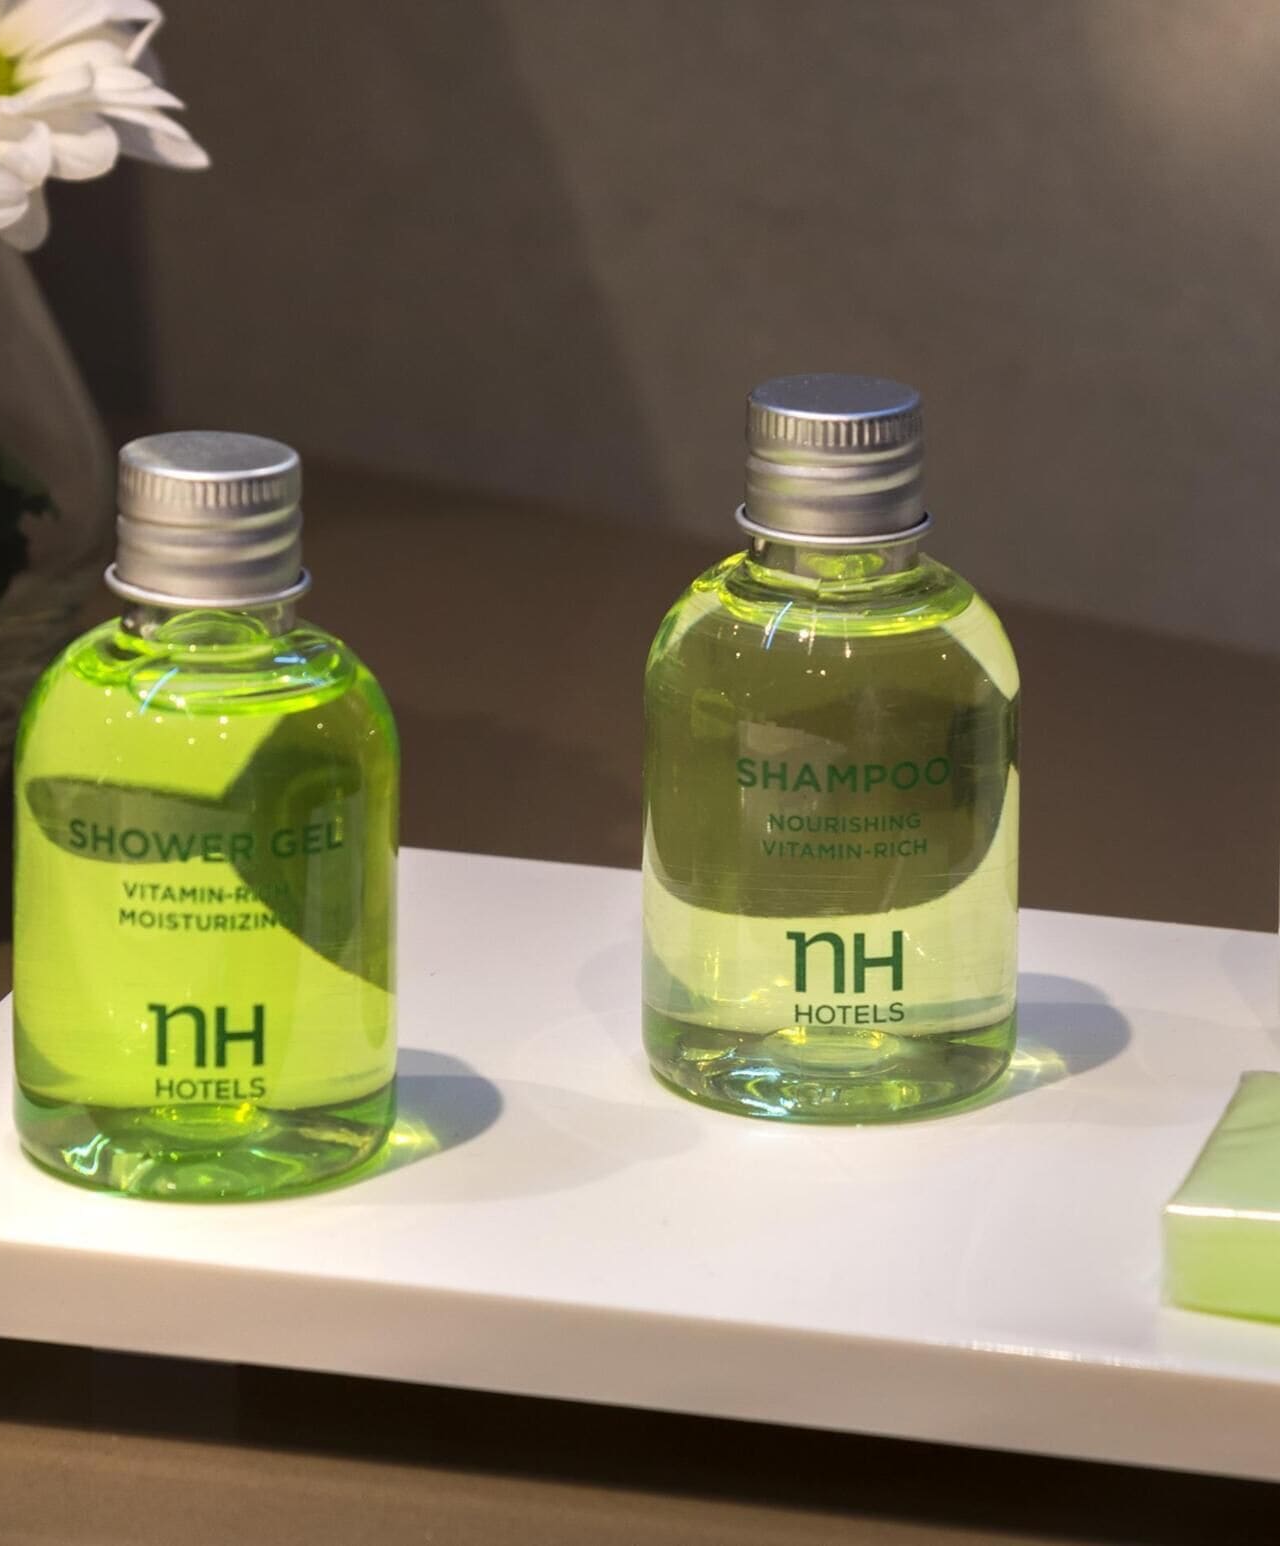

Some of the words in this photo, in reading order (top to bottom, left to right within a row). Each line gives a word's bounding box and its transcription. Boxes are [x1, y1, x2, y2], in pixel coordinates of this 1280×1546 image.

[736, 757, 951, 793] SHAMPOO
[769, 812, 921, 834] NOURISHING
[69, 819, 257, 863] SHOWER
[271, 823, 342, 859] GEL
[762, 838, 927, 860] VITAMIN-RICH
[122, 880, 289, 905] VITAMIN-RICH
[795, 1002, 905, 1024] HOTELS
[155, 1078, 266, 1100] HOTELS
